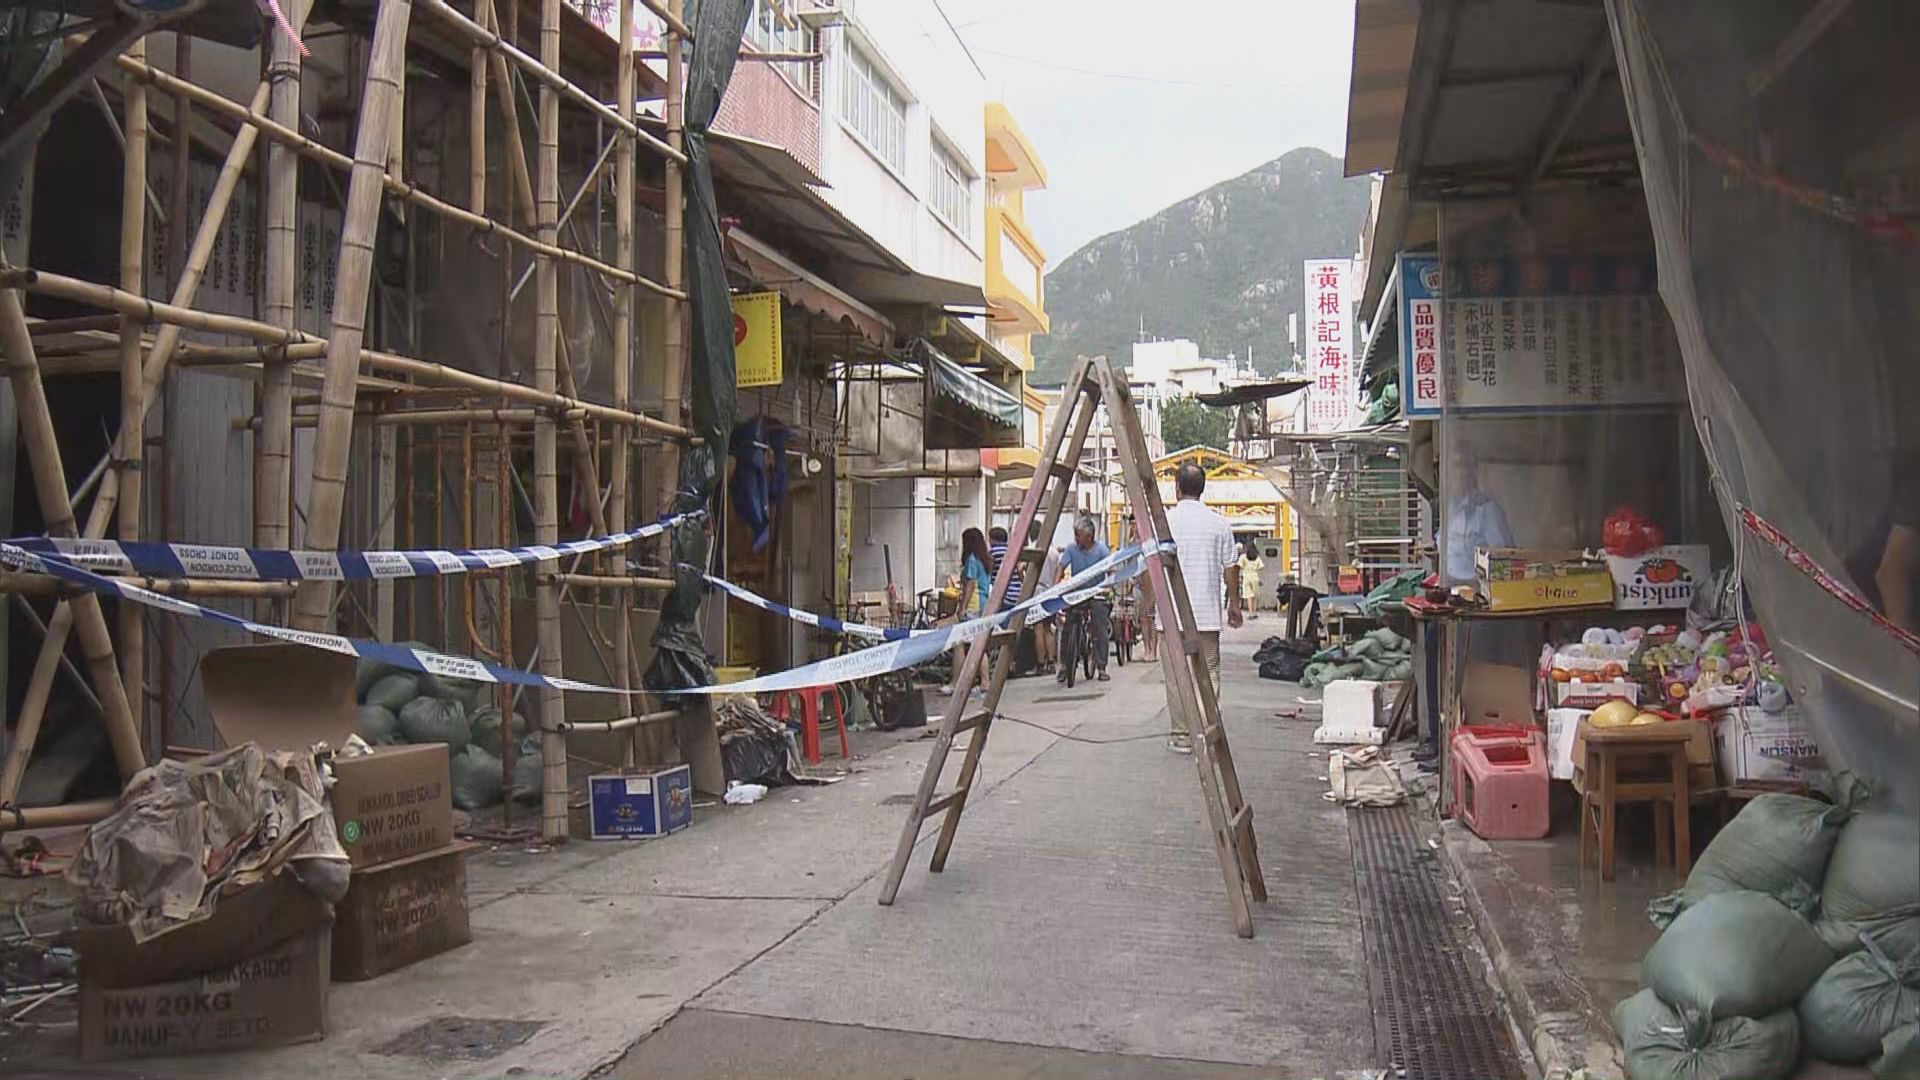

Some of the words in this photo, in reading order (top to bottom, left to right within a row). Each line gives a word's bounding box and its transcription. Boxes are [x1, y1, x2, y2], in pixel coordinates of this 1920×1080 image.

[1415, 303, 1437, 399] 品質優良
[1619, 583, 1691, 605] unkist
[388, 809, 420, 831] 20KG
[103, 995, 148, 1018] NW
[156, 991, 232, 1017] 20KG
